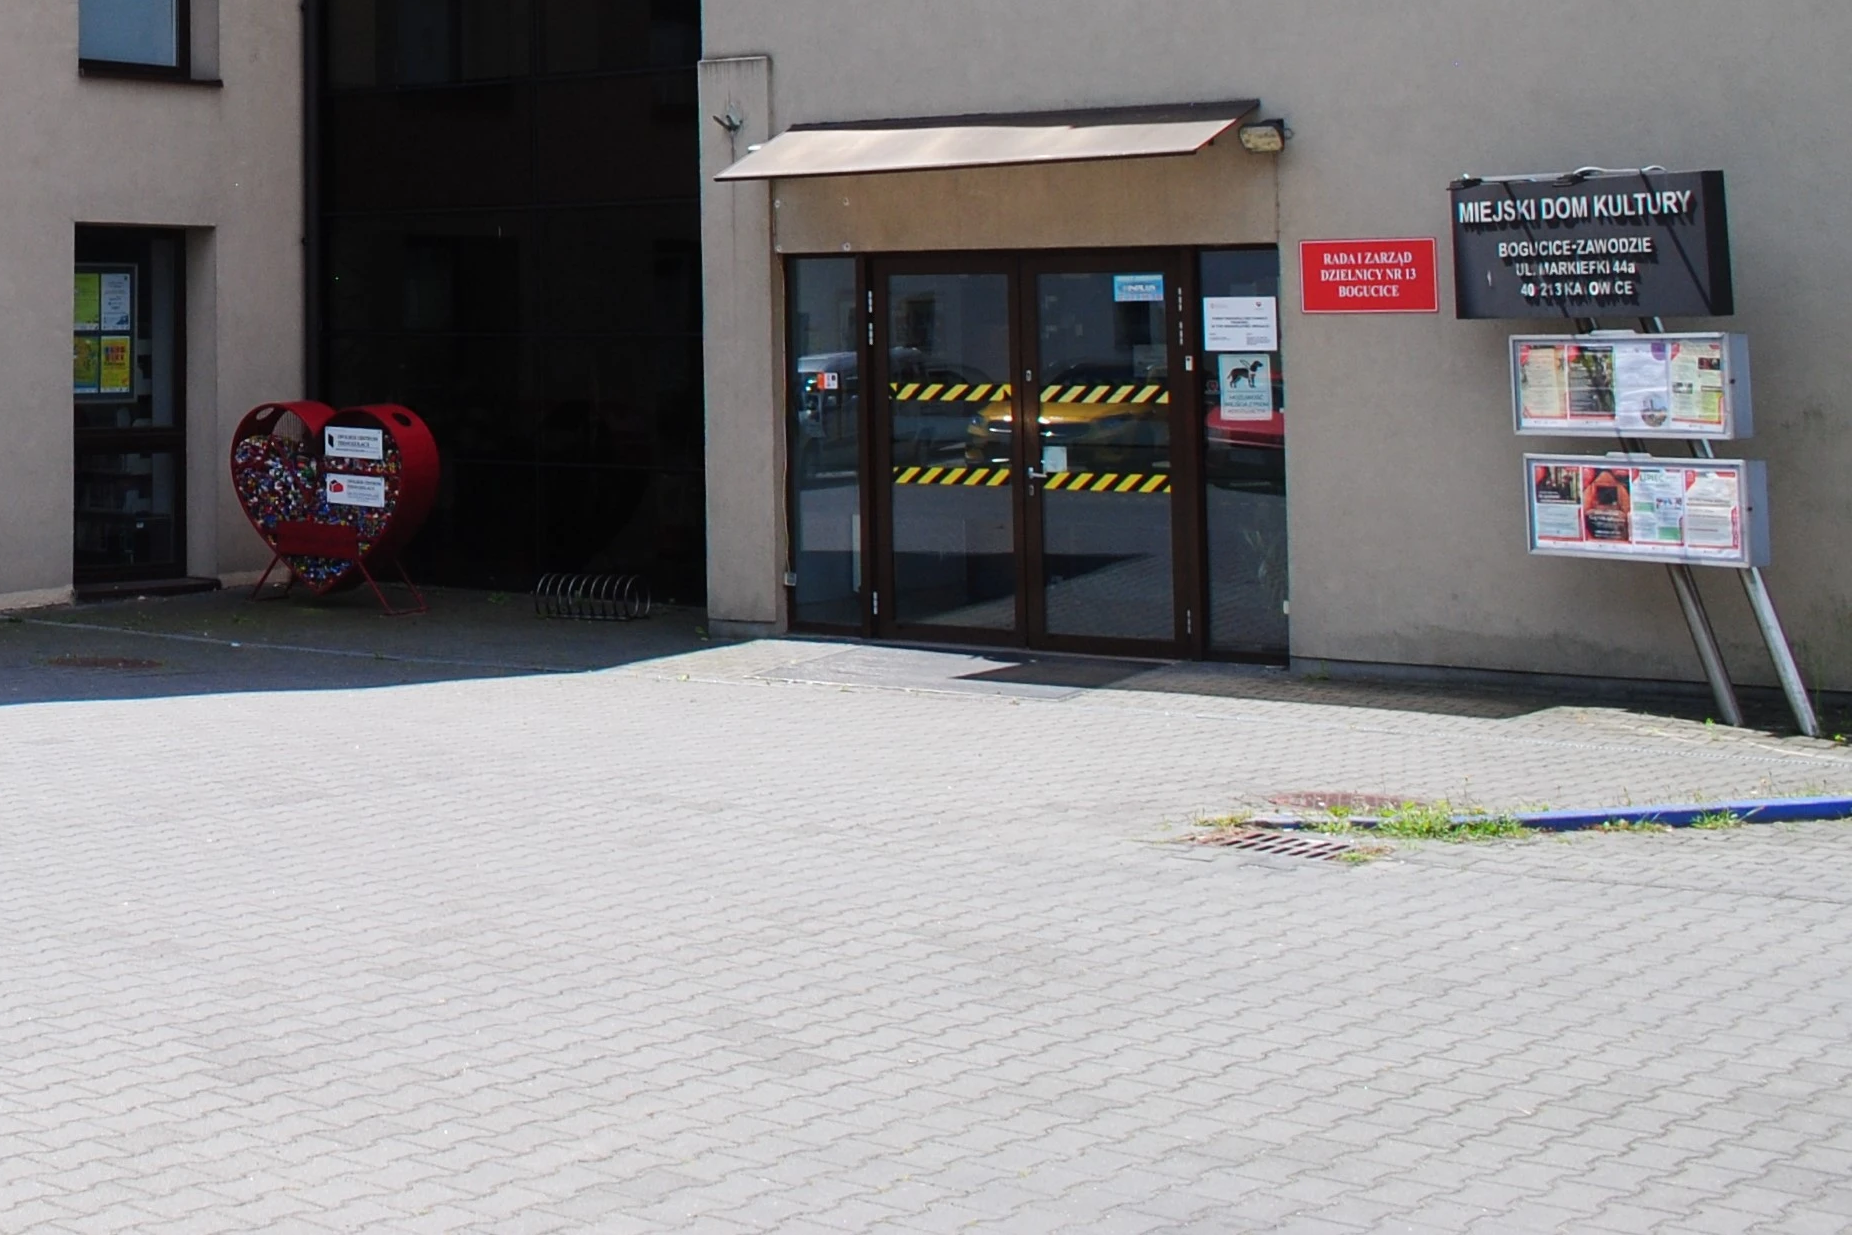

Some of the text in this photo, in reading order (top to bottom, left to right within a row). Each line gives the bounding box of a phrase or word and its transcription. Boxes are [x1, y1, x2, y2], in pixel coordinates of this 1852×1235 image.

[1458, 190, 1692, 224] MIEJSKI DOM KULTURY
[1498, 237, 1652, 258] BOGUCICE-ZAWODZIE
[1323, 251, 1413, 266] RADA I ZARZĄD
[1320, 268, 1416, 281] DZIELNICY NR 13
[1515, 260, 1636, 277] UL. MARKIEFKI 44a
[1338, 285, 1399, 298] BOGUCICE
[1564, 281, 1633, 296] KAOWCE
